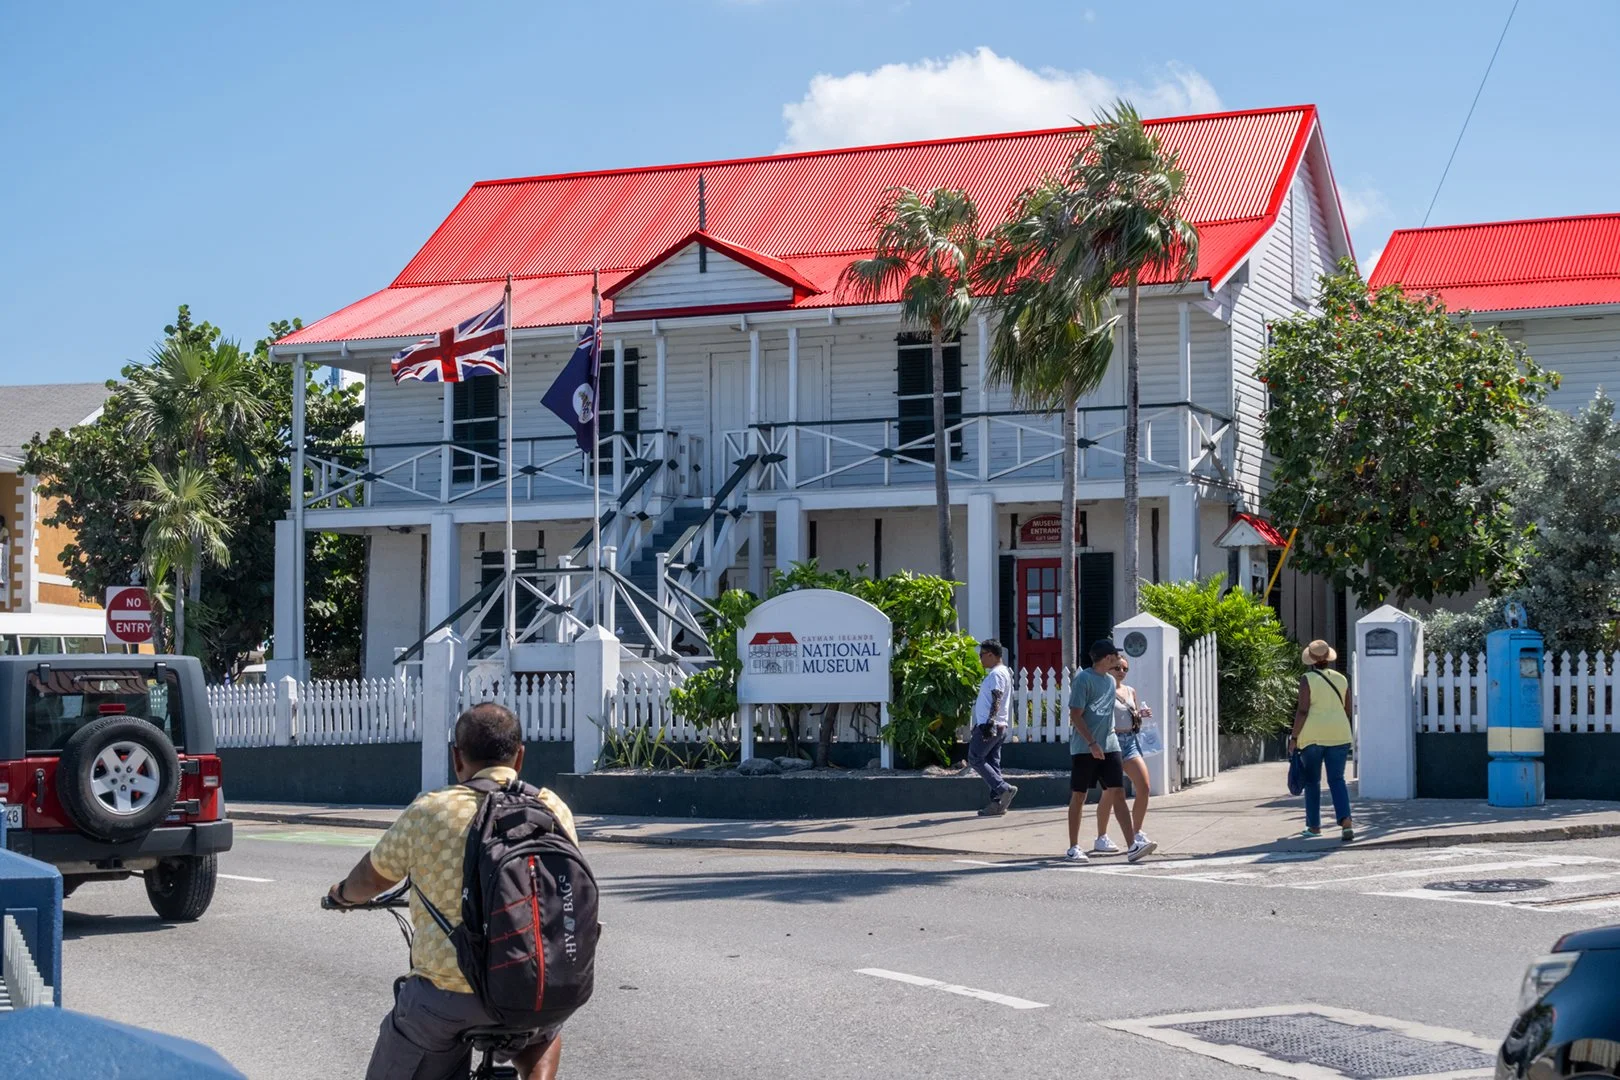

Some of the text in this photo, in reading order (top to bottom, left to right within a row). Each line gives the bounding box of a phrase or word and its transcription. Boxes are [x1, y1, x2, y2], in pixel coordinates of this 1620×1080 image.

[1030, 527, 1061, 535] ENTRANC
[126, 597, 142, 608] NO
[116, 622, 152, 633] ENTRY
[802, 642, 881, 658] NATIONAL
[802, 658, 870, 673] MUSEUM
[558, 875, 574, 912] BAGS
